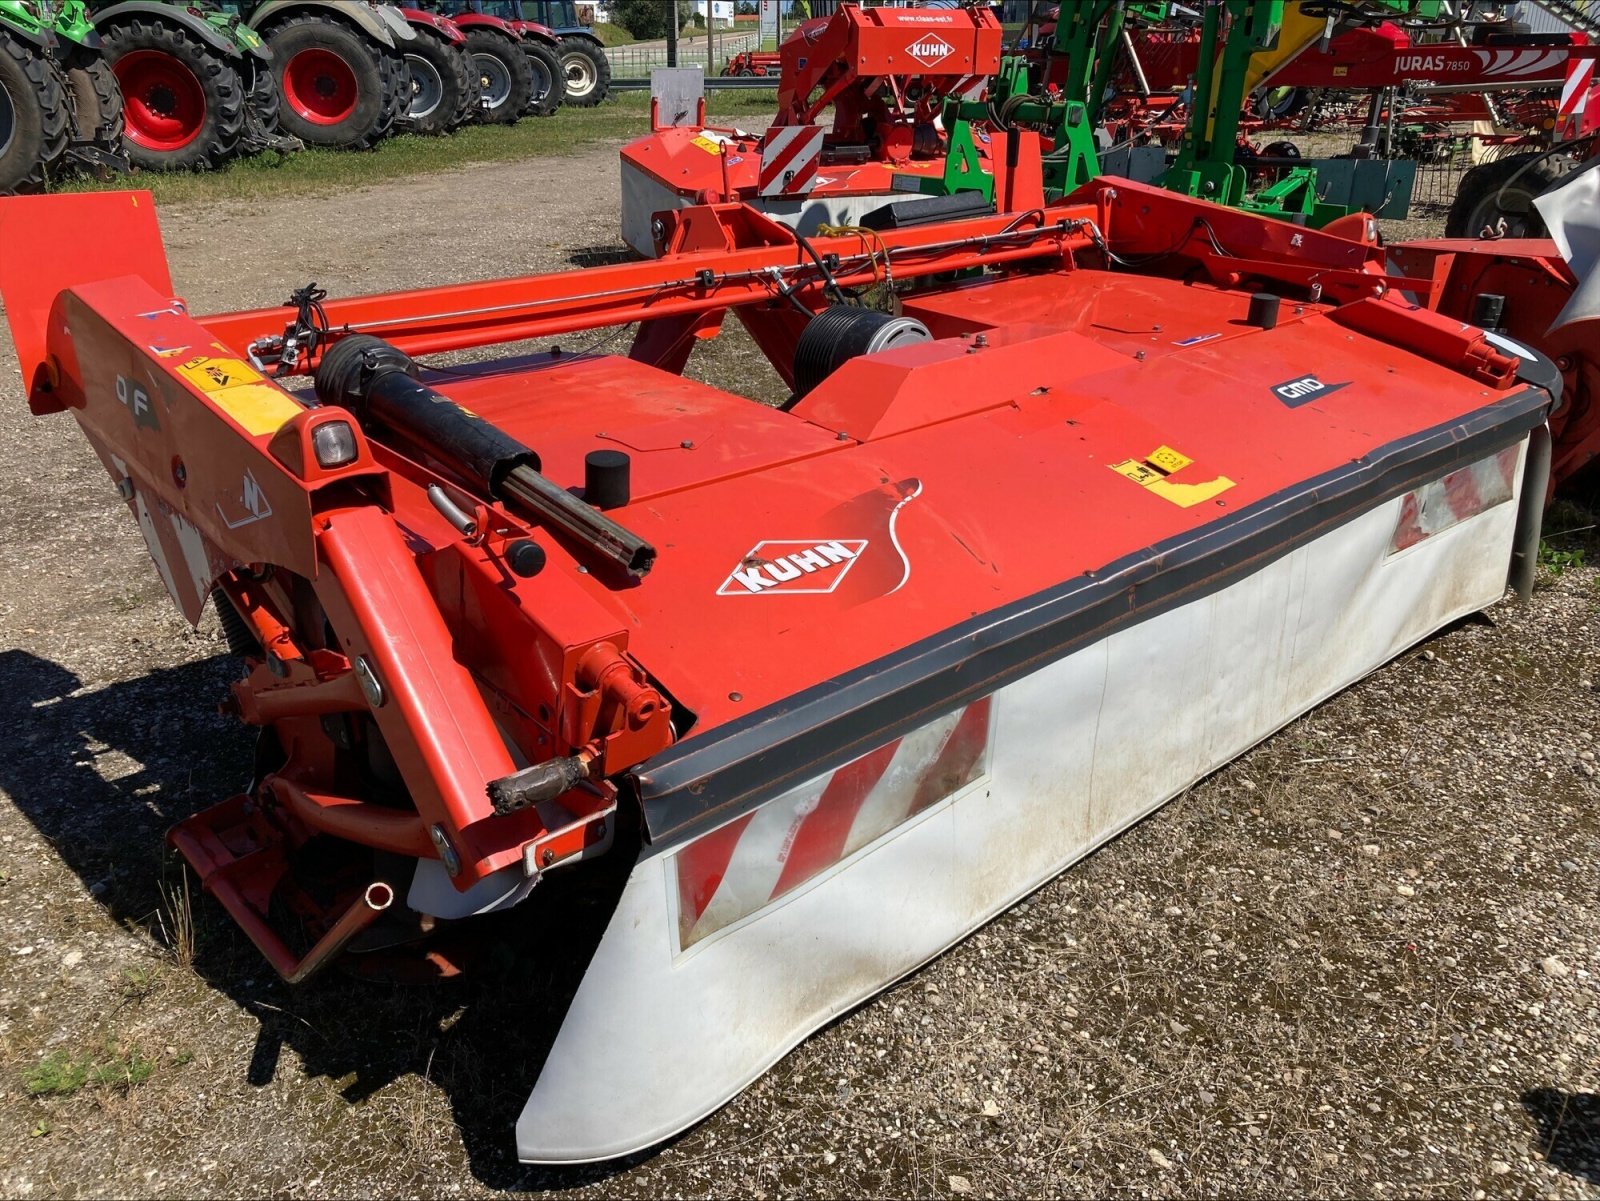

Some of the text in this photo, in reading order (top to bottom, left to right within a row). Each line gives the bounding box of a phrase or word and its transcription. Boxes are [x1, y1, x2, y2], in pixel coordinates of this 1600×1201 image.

[912, 44, 948, 56] KUHN
[1393, 55, 1470, 74] JURAS 7850
[1277, 378, 1325, 398] GMD
[732, 541, 857, 593] KUHN
